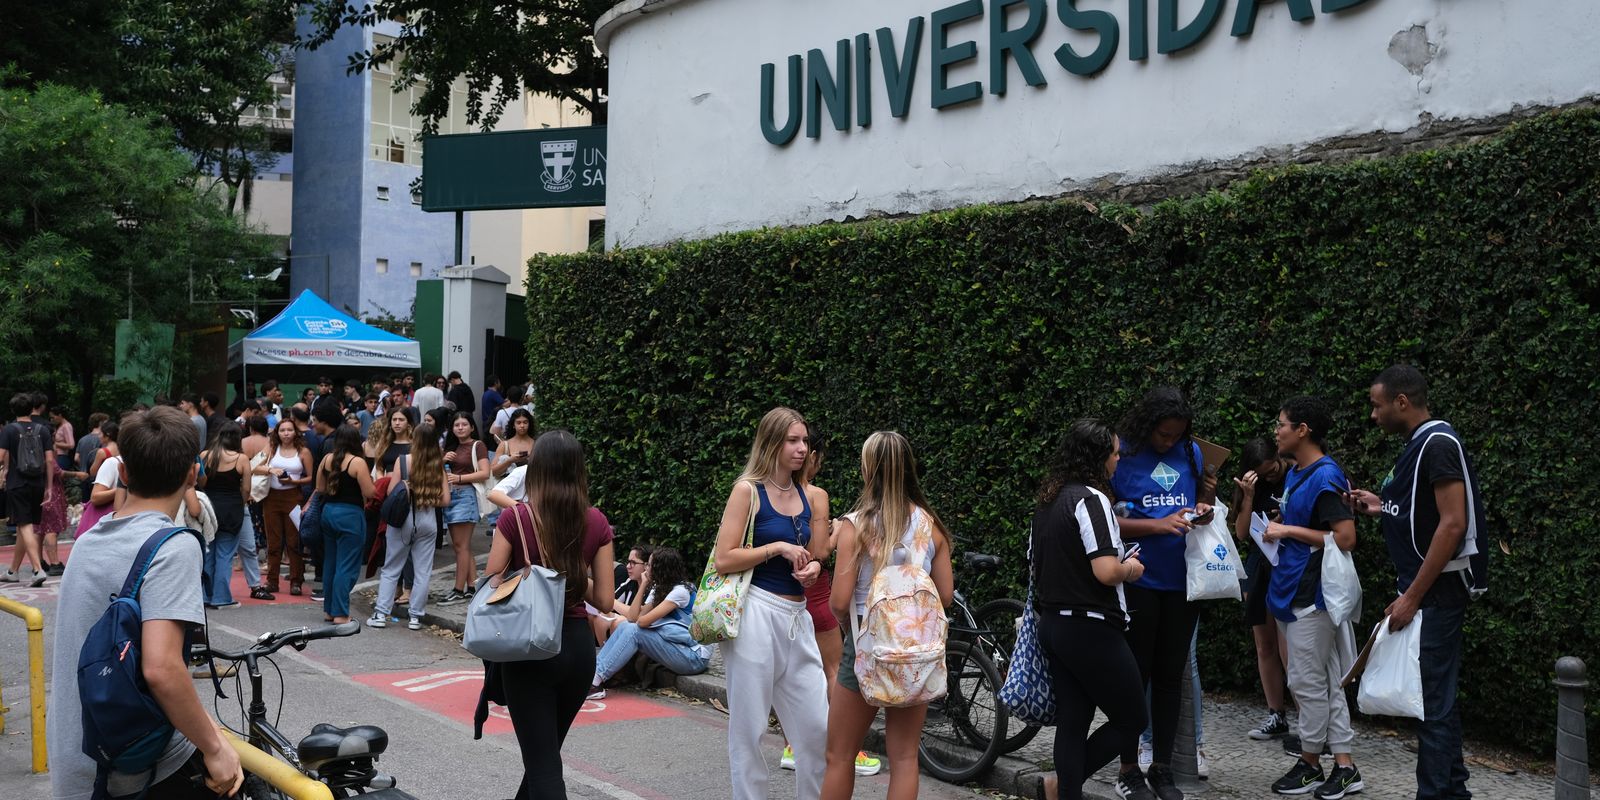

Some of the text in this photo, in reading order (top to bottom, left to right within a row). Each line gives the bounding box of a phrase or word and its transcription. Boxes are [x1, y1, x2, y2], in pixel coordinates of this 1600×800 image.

[760, 0, 1384, 145] UNIVERSID
[583, 147, 607, 166] UN
[582, 168, 605, 186] SA
[256, 348, 287, 356] Acesse
[288, 348, 335, 357] ph.com.br
[344, 349, 383, 358] descubra
[452, 345, 463, 353] 75
